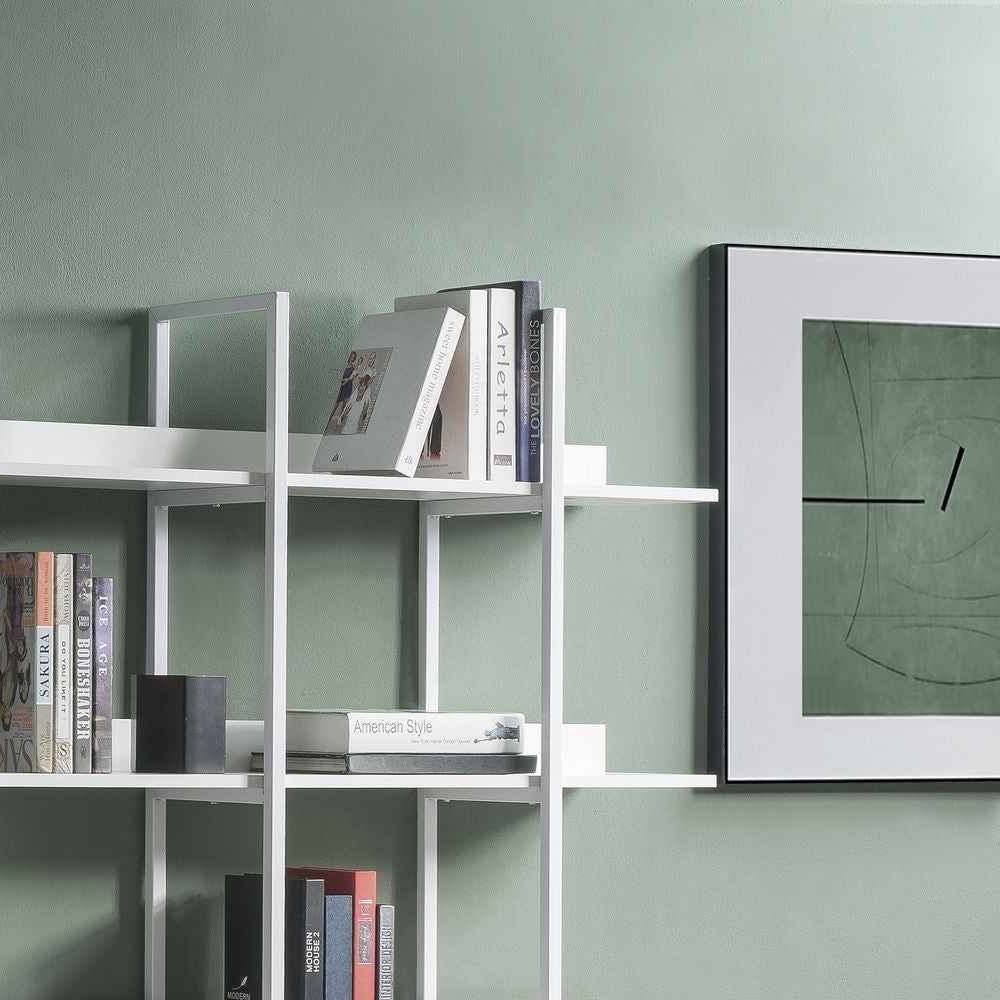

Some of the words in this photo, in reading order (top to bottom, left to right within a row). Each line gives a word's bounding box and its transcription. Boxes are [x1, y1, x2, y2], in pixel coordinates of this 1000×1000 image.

[442, 320, 457, 350] sweet
[529, 320, 540, 373] BONES
[431, 351, 448, 380] home
[495, 321, 510, 435] Arletta
[415, 382, 437, 431] magazine
[530, 377, 540, 438] LOVELY
[99, 595, 108, 626] ICE
[39, 633, 50, 697] SAKURA
[99, 641, 108, 676] AGE
[76, 638, 91, 740] BONESHAKER
[61, 704, 66, 713] IT
[353, 719, 404, 734] American
[406, 719, 433, 737] Style
[380, 924, 392, 956] DESIGN
[227, 991, 251, 1000] MODERN
[380, 959, 392, 1000] INTERIOR
